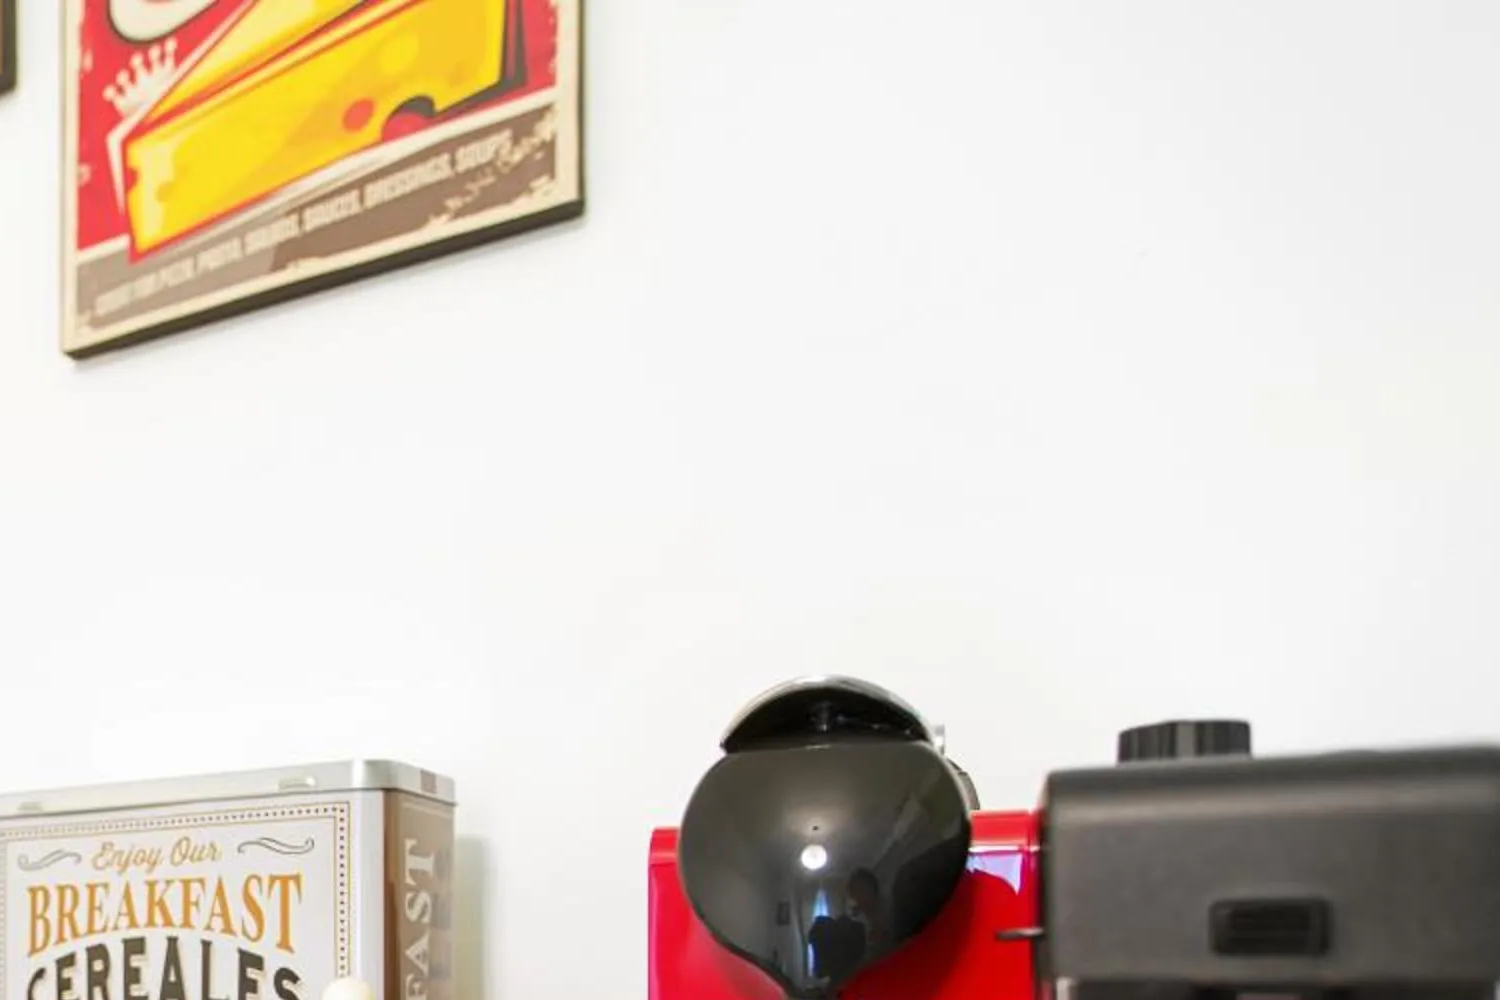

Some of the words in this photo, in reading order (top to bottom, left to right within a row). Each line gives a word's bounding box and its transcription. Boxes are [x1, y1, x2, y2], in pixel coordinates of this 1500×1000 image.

[92, 842, 164, 875] Enjoy
[170, 837, 220, 866] Our
[27, 873, 302, 957] BREAKFAST
